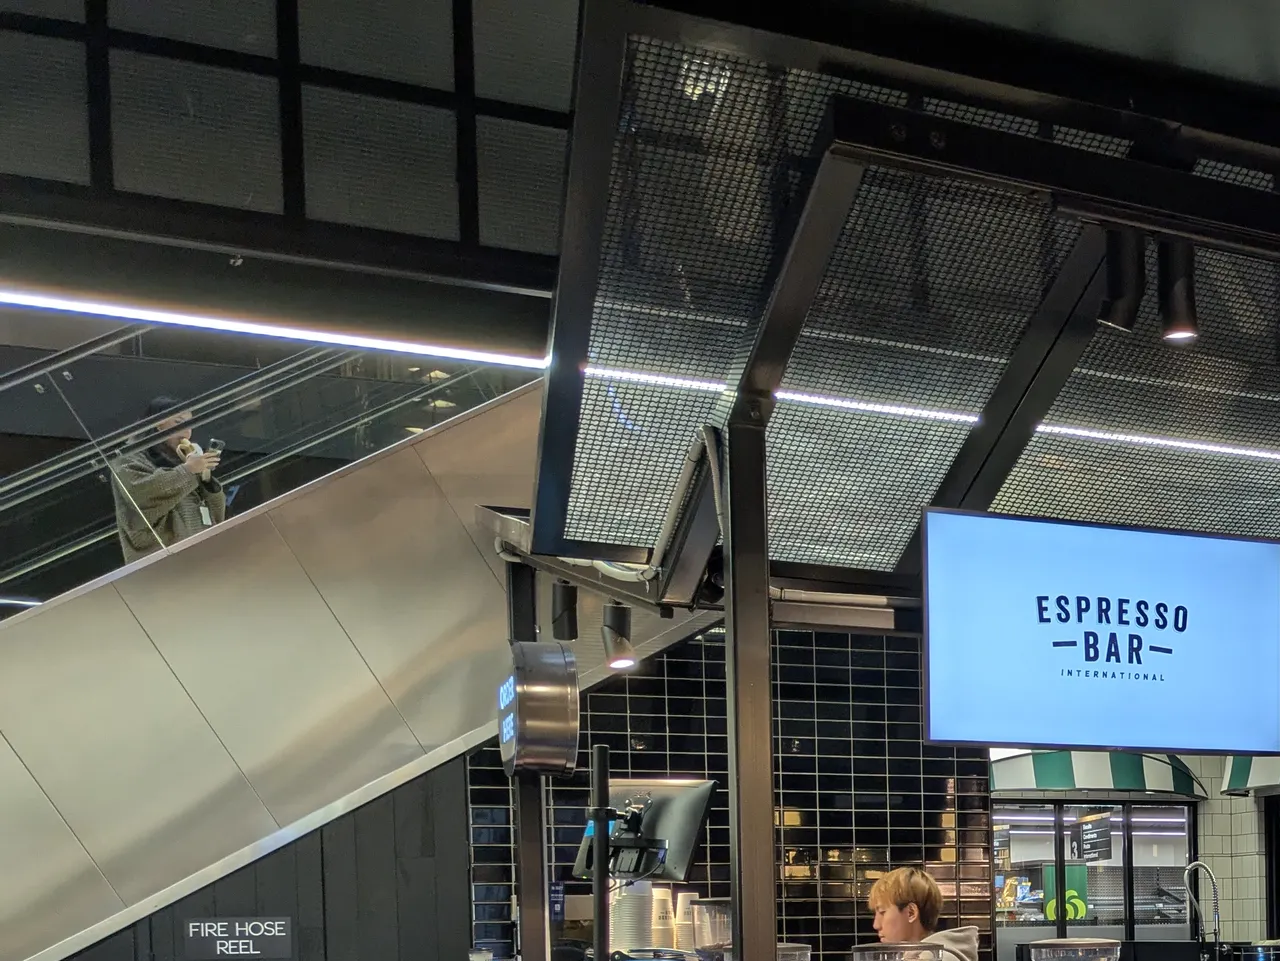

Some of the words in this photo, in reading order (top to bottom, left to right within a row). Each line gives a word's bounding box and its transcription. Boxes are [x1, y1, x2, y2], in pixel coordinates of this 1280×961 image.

[1036, 595, 1188, 632] ESPRESSO
[1083, 631, 1143, 664] BAR
[1061, 669, 1165, 681] INTERNATIONAL
[189, 922, 229, 938] FIRE
[235, 921, 286, 936] HOSE
[216, 940, 261, 955] REEL
